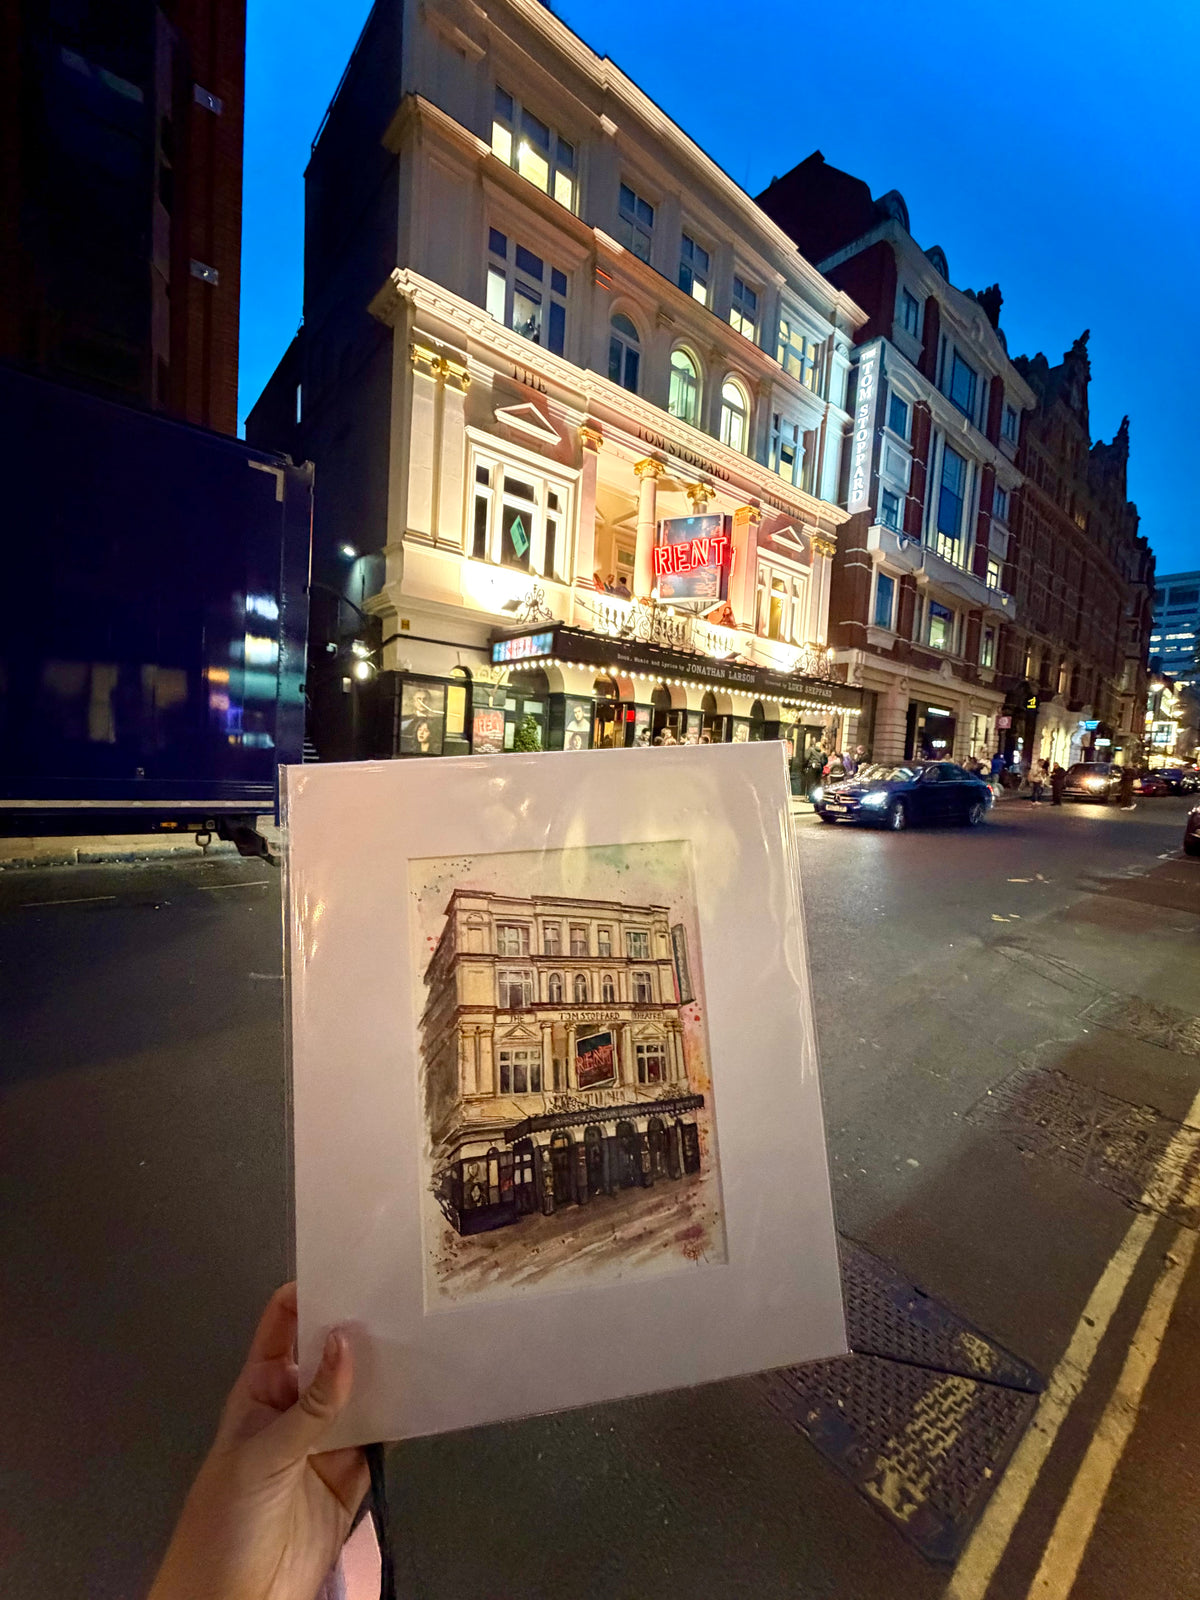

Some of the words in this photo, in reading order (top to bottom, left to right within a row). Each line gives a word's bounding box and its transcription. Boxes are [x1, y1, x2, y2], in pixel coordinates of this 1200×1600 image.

[508, 362, 548, 394] THE
[859, 361, 874, 401] TOM
[638, 426, 665, 449] TOM
[669, 442, 730, 482] STOPPARD
[851, 403, 869, 503] STOPPARD
[653, 536, 728, 576] RENT
[686, 663, 725, 678] JONATHAN
[728, 670, 756, 683] LARSON
[788, 682, 803, 693] LUKE
[804, 685, 832, 698] SHEPPARD
[560, 1012, 579, 1020] TOM
[576, 1044, 613, 1075] RENT
